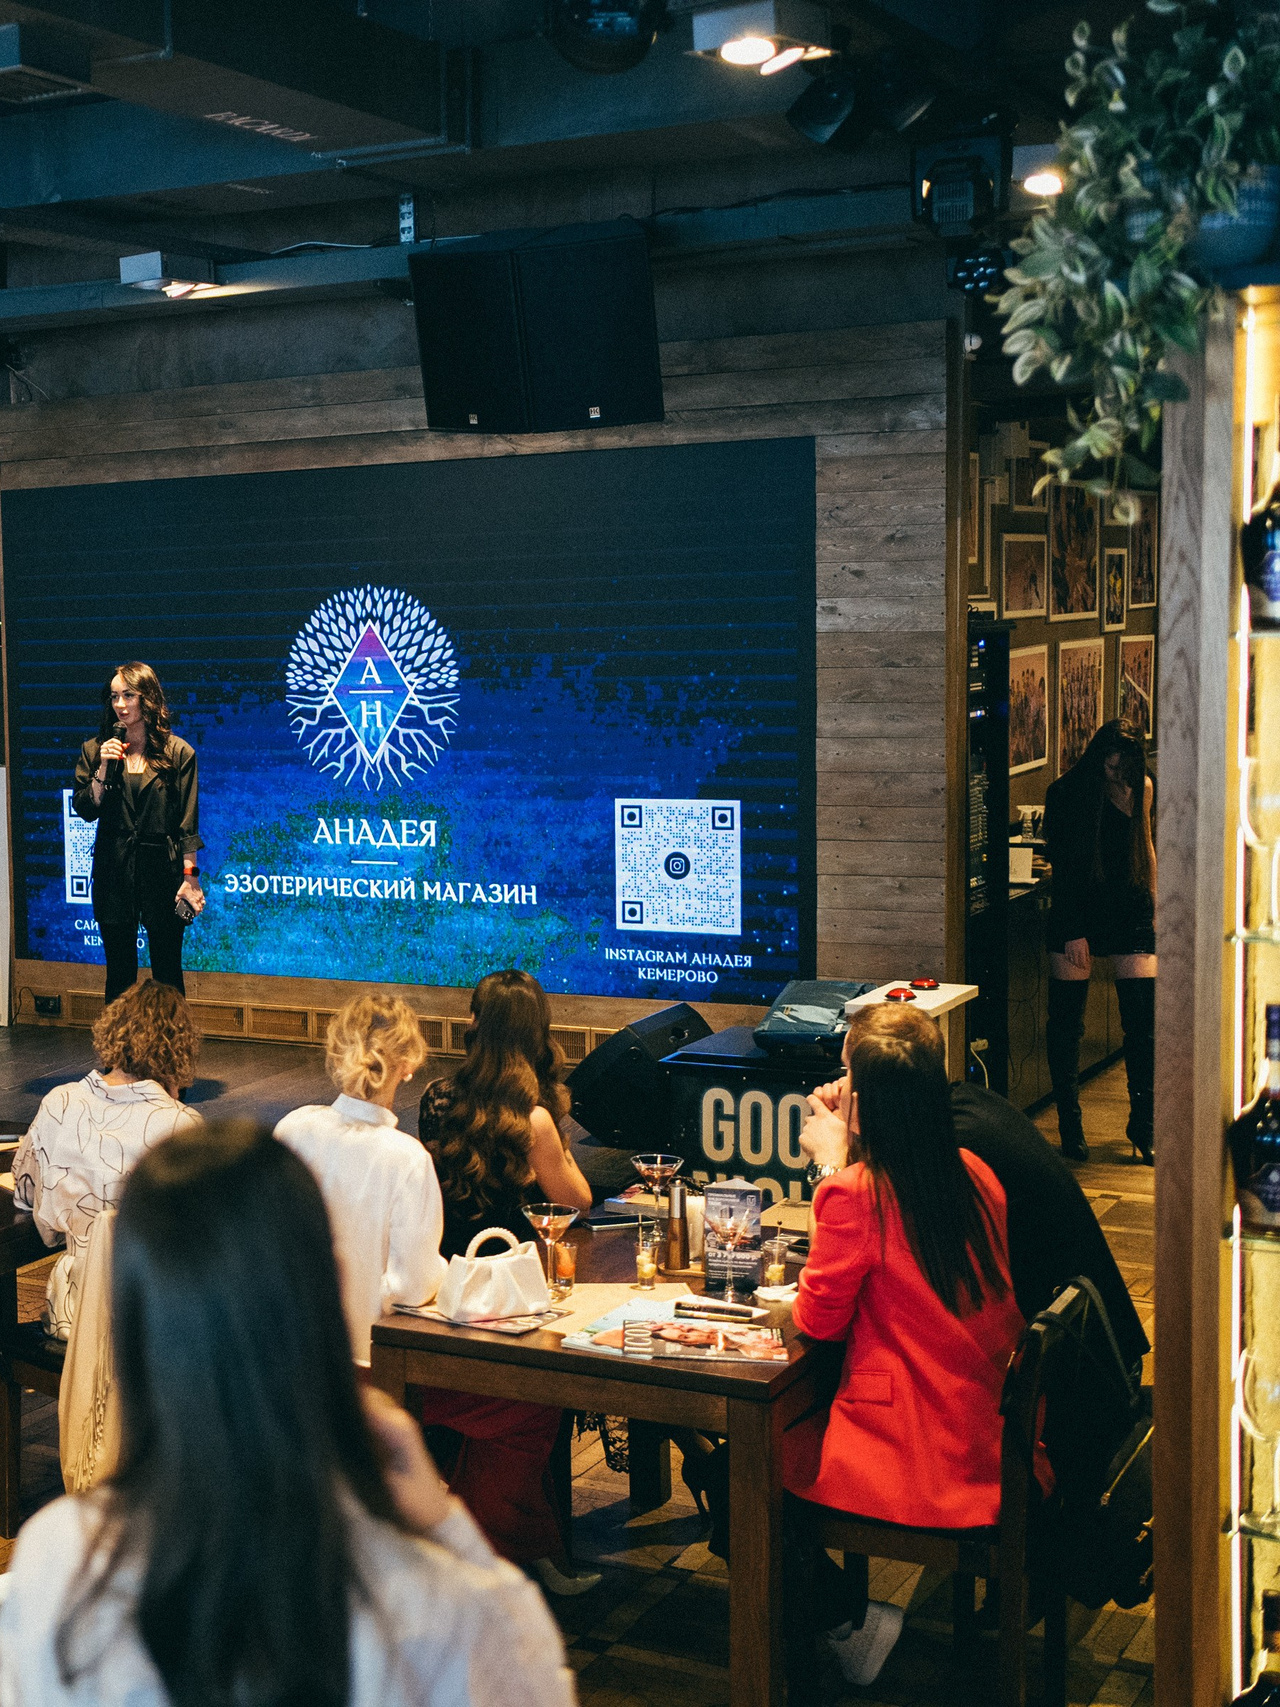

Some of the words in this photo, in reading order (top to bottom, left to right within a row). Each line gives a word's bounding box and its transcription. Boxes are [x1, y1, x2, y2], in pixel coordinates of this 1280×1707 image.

[314, 818, 437, 849] АНАДЕЯ
[225, 873, 417, 901] ЭЗОТЕРИЧЕСКИЙ
[423, 880, 538, 905] МАГАЗИН
[74, 918, 99, 931] САЙ
[605, 948, 687, 966] INSTAGRAM
[690, 953, 753, 972] АНАДЕЯ
[638, 966, 719, 984] КЕМЕРОВО
[702, 1087, 811, 1169] GOO
